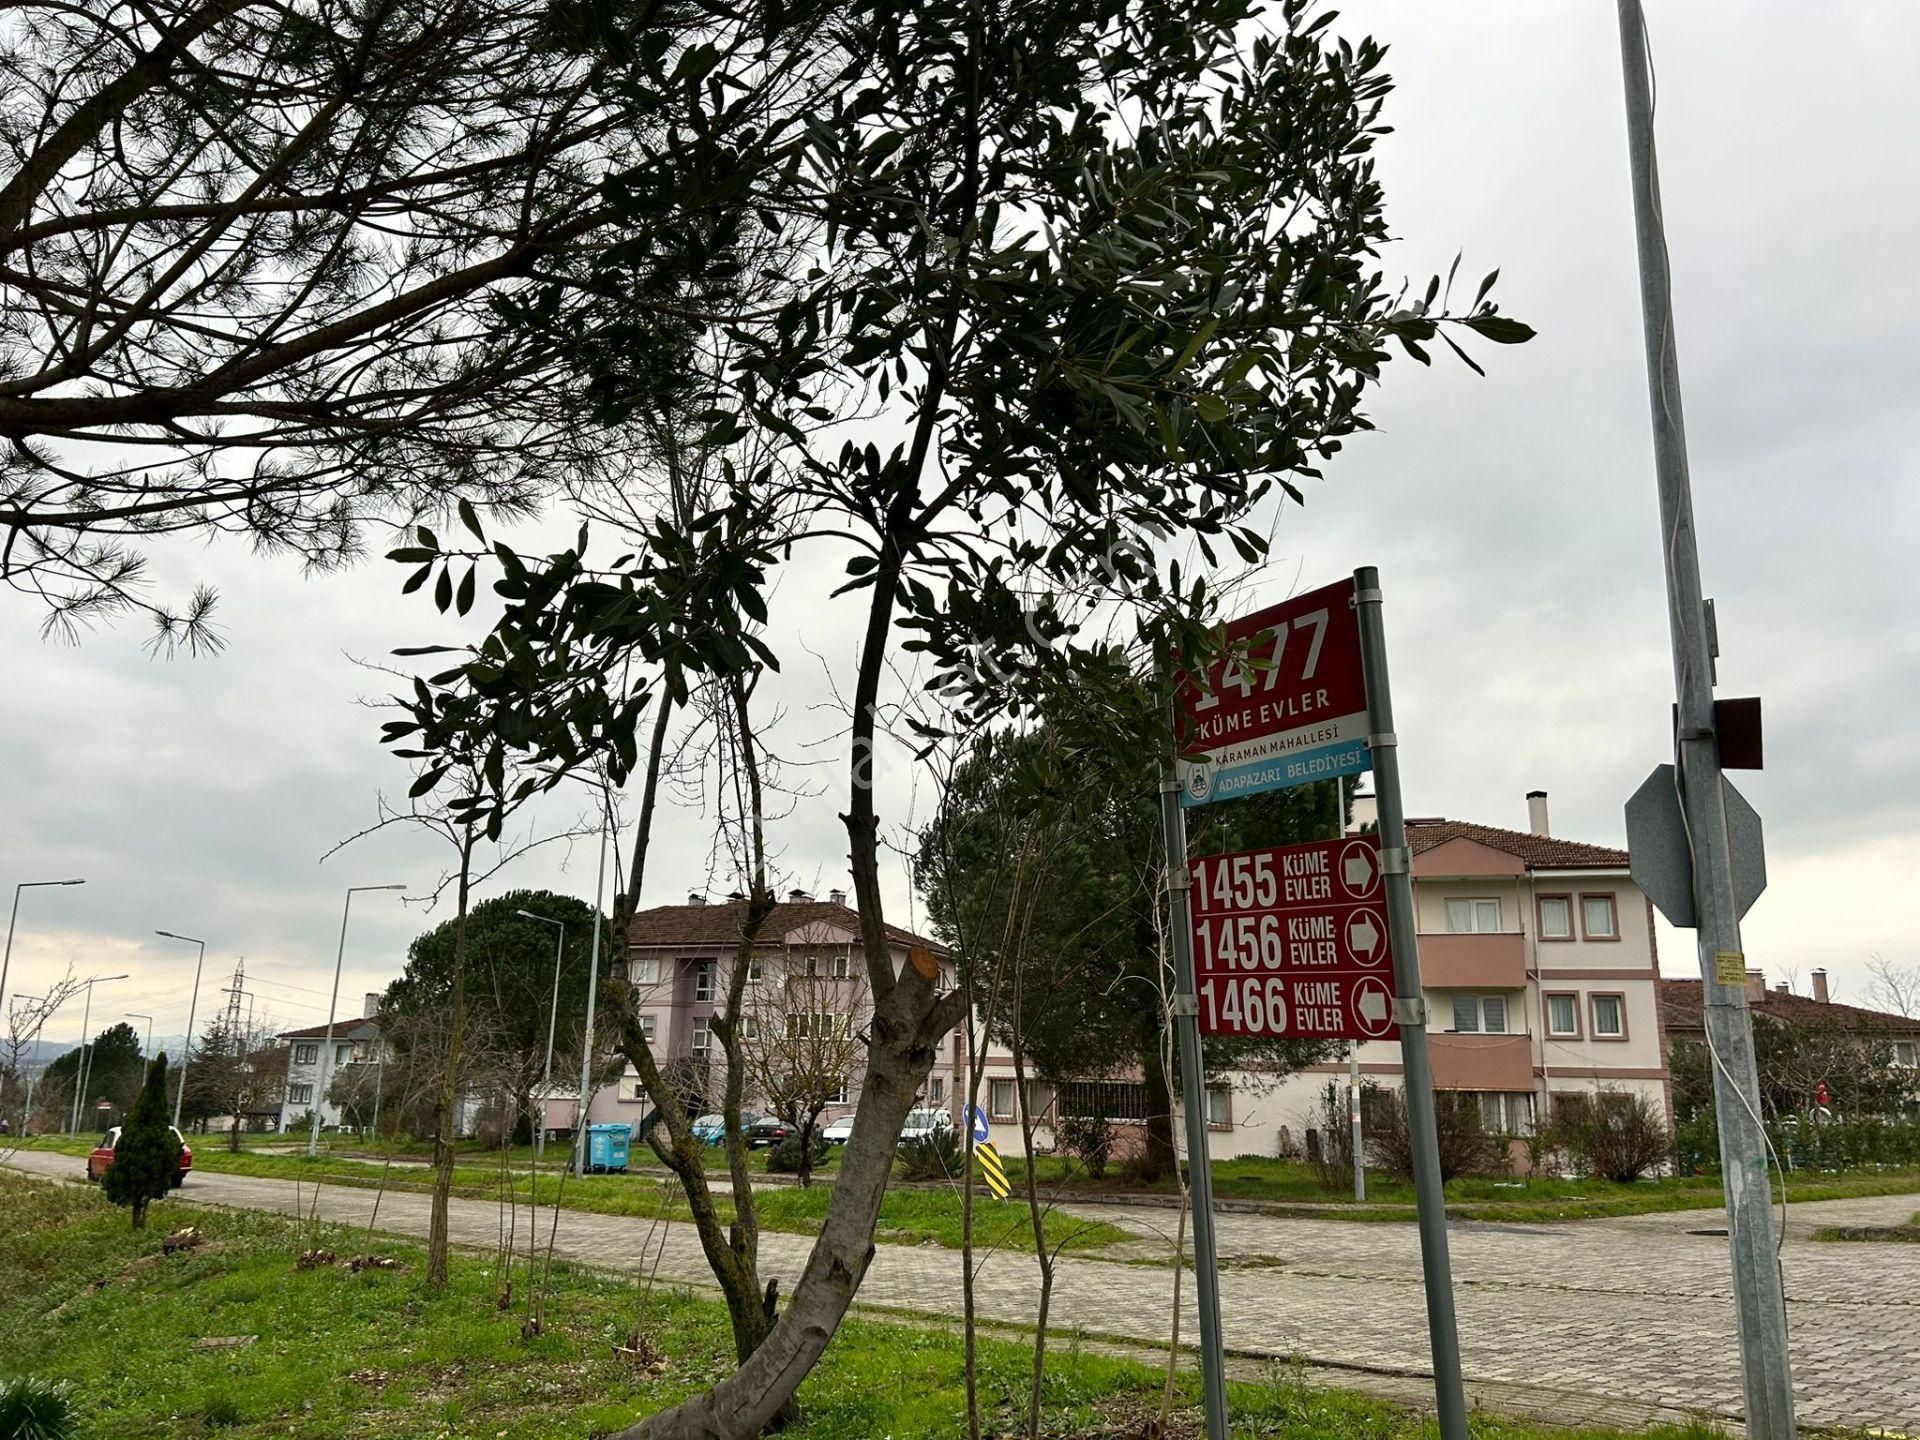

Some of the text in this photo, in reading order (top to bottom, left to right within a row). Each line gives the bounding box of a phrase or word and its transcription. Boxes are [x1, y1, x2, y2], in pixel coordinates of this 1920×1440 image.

[1195, 607, 1329, 712] 1477
[1199, 688, 1330, 740] KÜME EVLER
[1215, 724, 1339, 767] KARAMAN MAHALLESİ
[1287, 746, 1362, 779] BELEDİYESİ
[1192, 850, 1330, 911] 1455 KÜME
[1284, 876, 1332, 901] EVLER
[1196, 914, 1336, 970] 1456 KÜME
[1290, 941, 1338, 966] EVLER
[1200, 977, 1342, 1034] 1466 KÜME
[1295, 1008, 1344, 1032] EVLER
